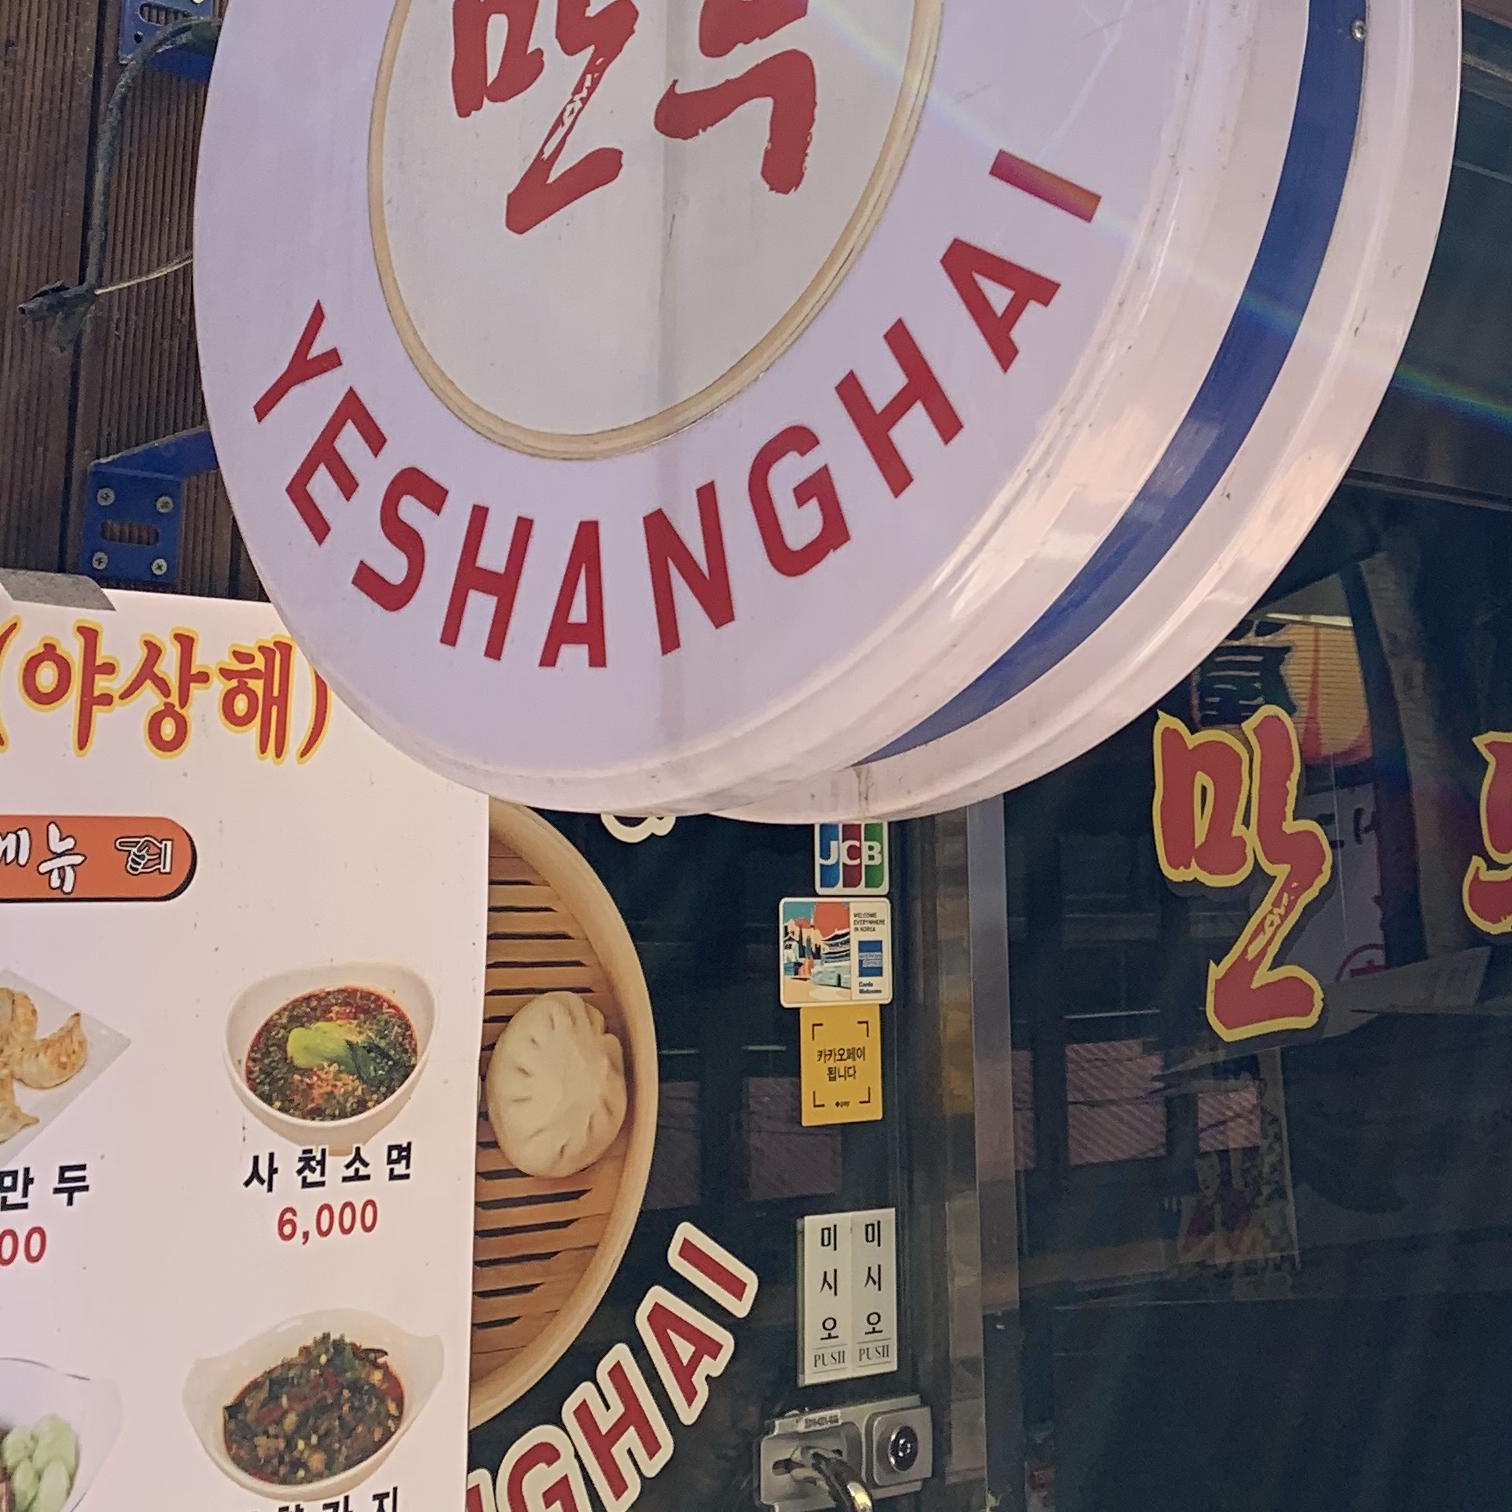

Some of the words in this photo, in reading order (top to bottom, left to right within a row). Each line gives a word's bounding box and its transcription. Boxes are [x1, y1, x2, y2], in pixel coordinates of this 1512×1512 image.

[253, 148, 1102, 669] YESHANGHAI
[819, 840, 882, 865] JCB
[816, 1045, 866, 1063] 카카오페이
[827, 1064, 857, 1081] 됩니다
[276, 1198, 379, 1245] 6,000
[820, 1224, 839, 1341] 미시오
[864, 1220, 883, 1335] 미시오
[813, 1350, 846, 1368] PUSH
[858, 1344, 890, 1362] PUSH
